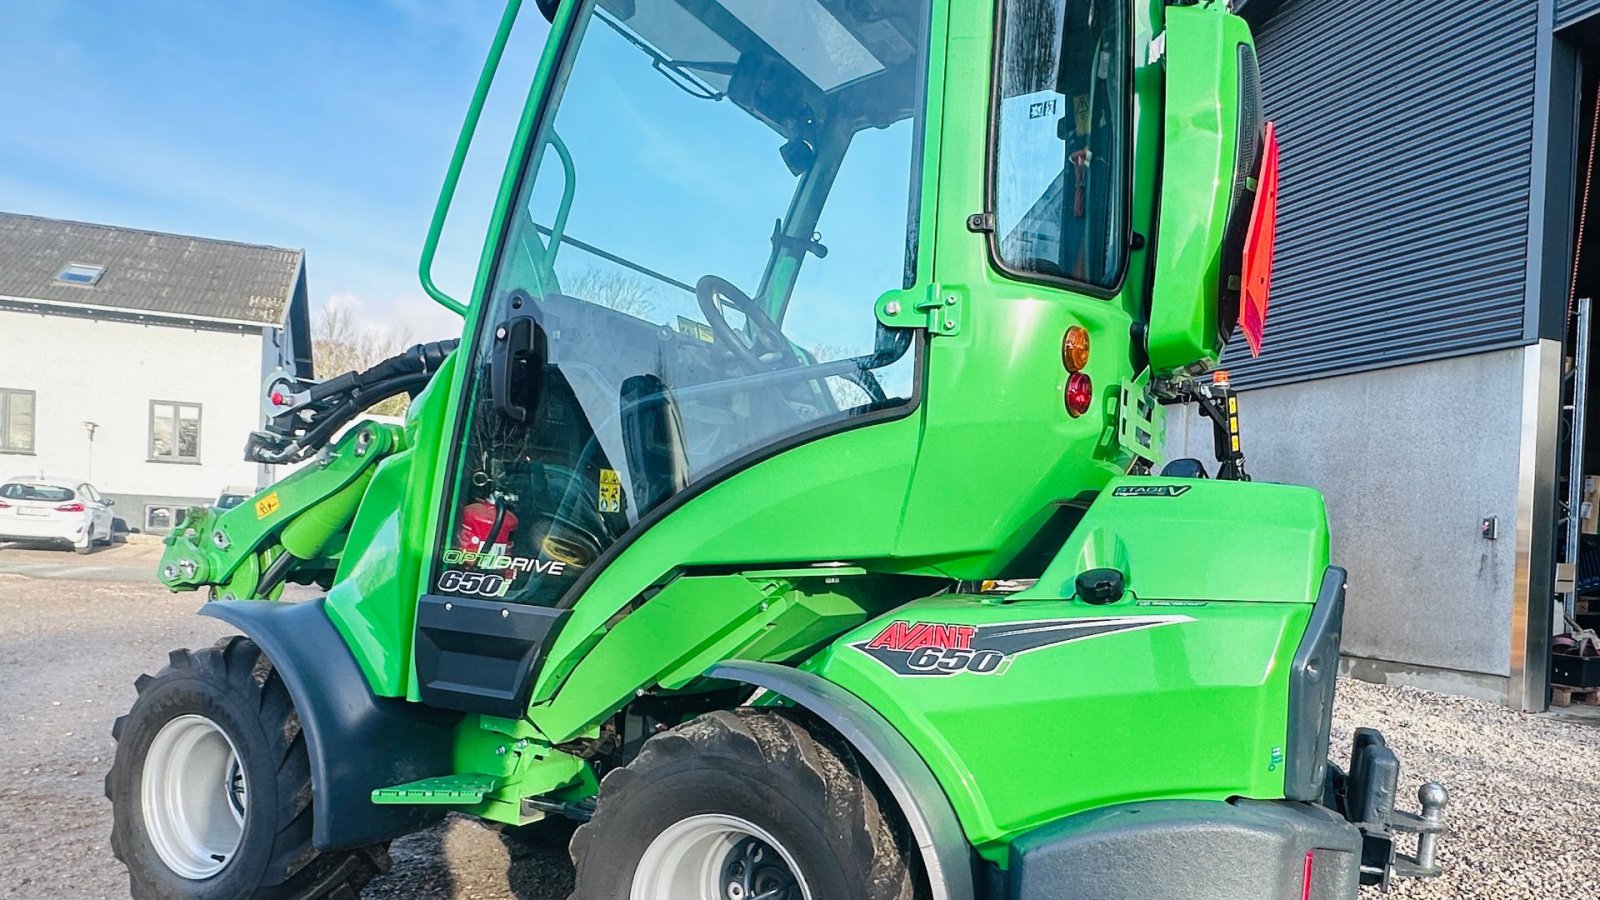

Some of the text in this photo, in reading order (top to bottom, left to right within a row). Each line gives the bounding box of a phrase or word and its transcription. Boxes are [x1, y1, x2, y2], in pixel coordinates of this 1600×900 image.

[443, 549, 566, 575] OPTIDRIVE
[438, 570, 513, 597] 650i
[866, 620, 977, 651] AVANT
[907, 647, 1017, 676] 650i
